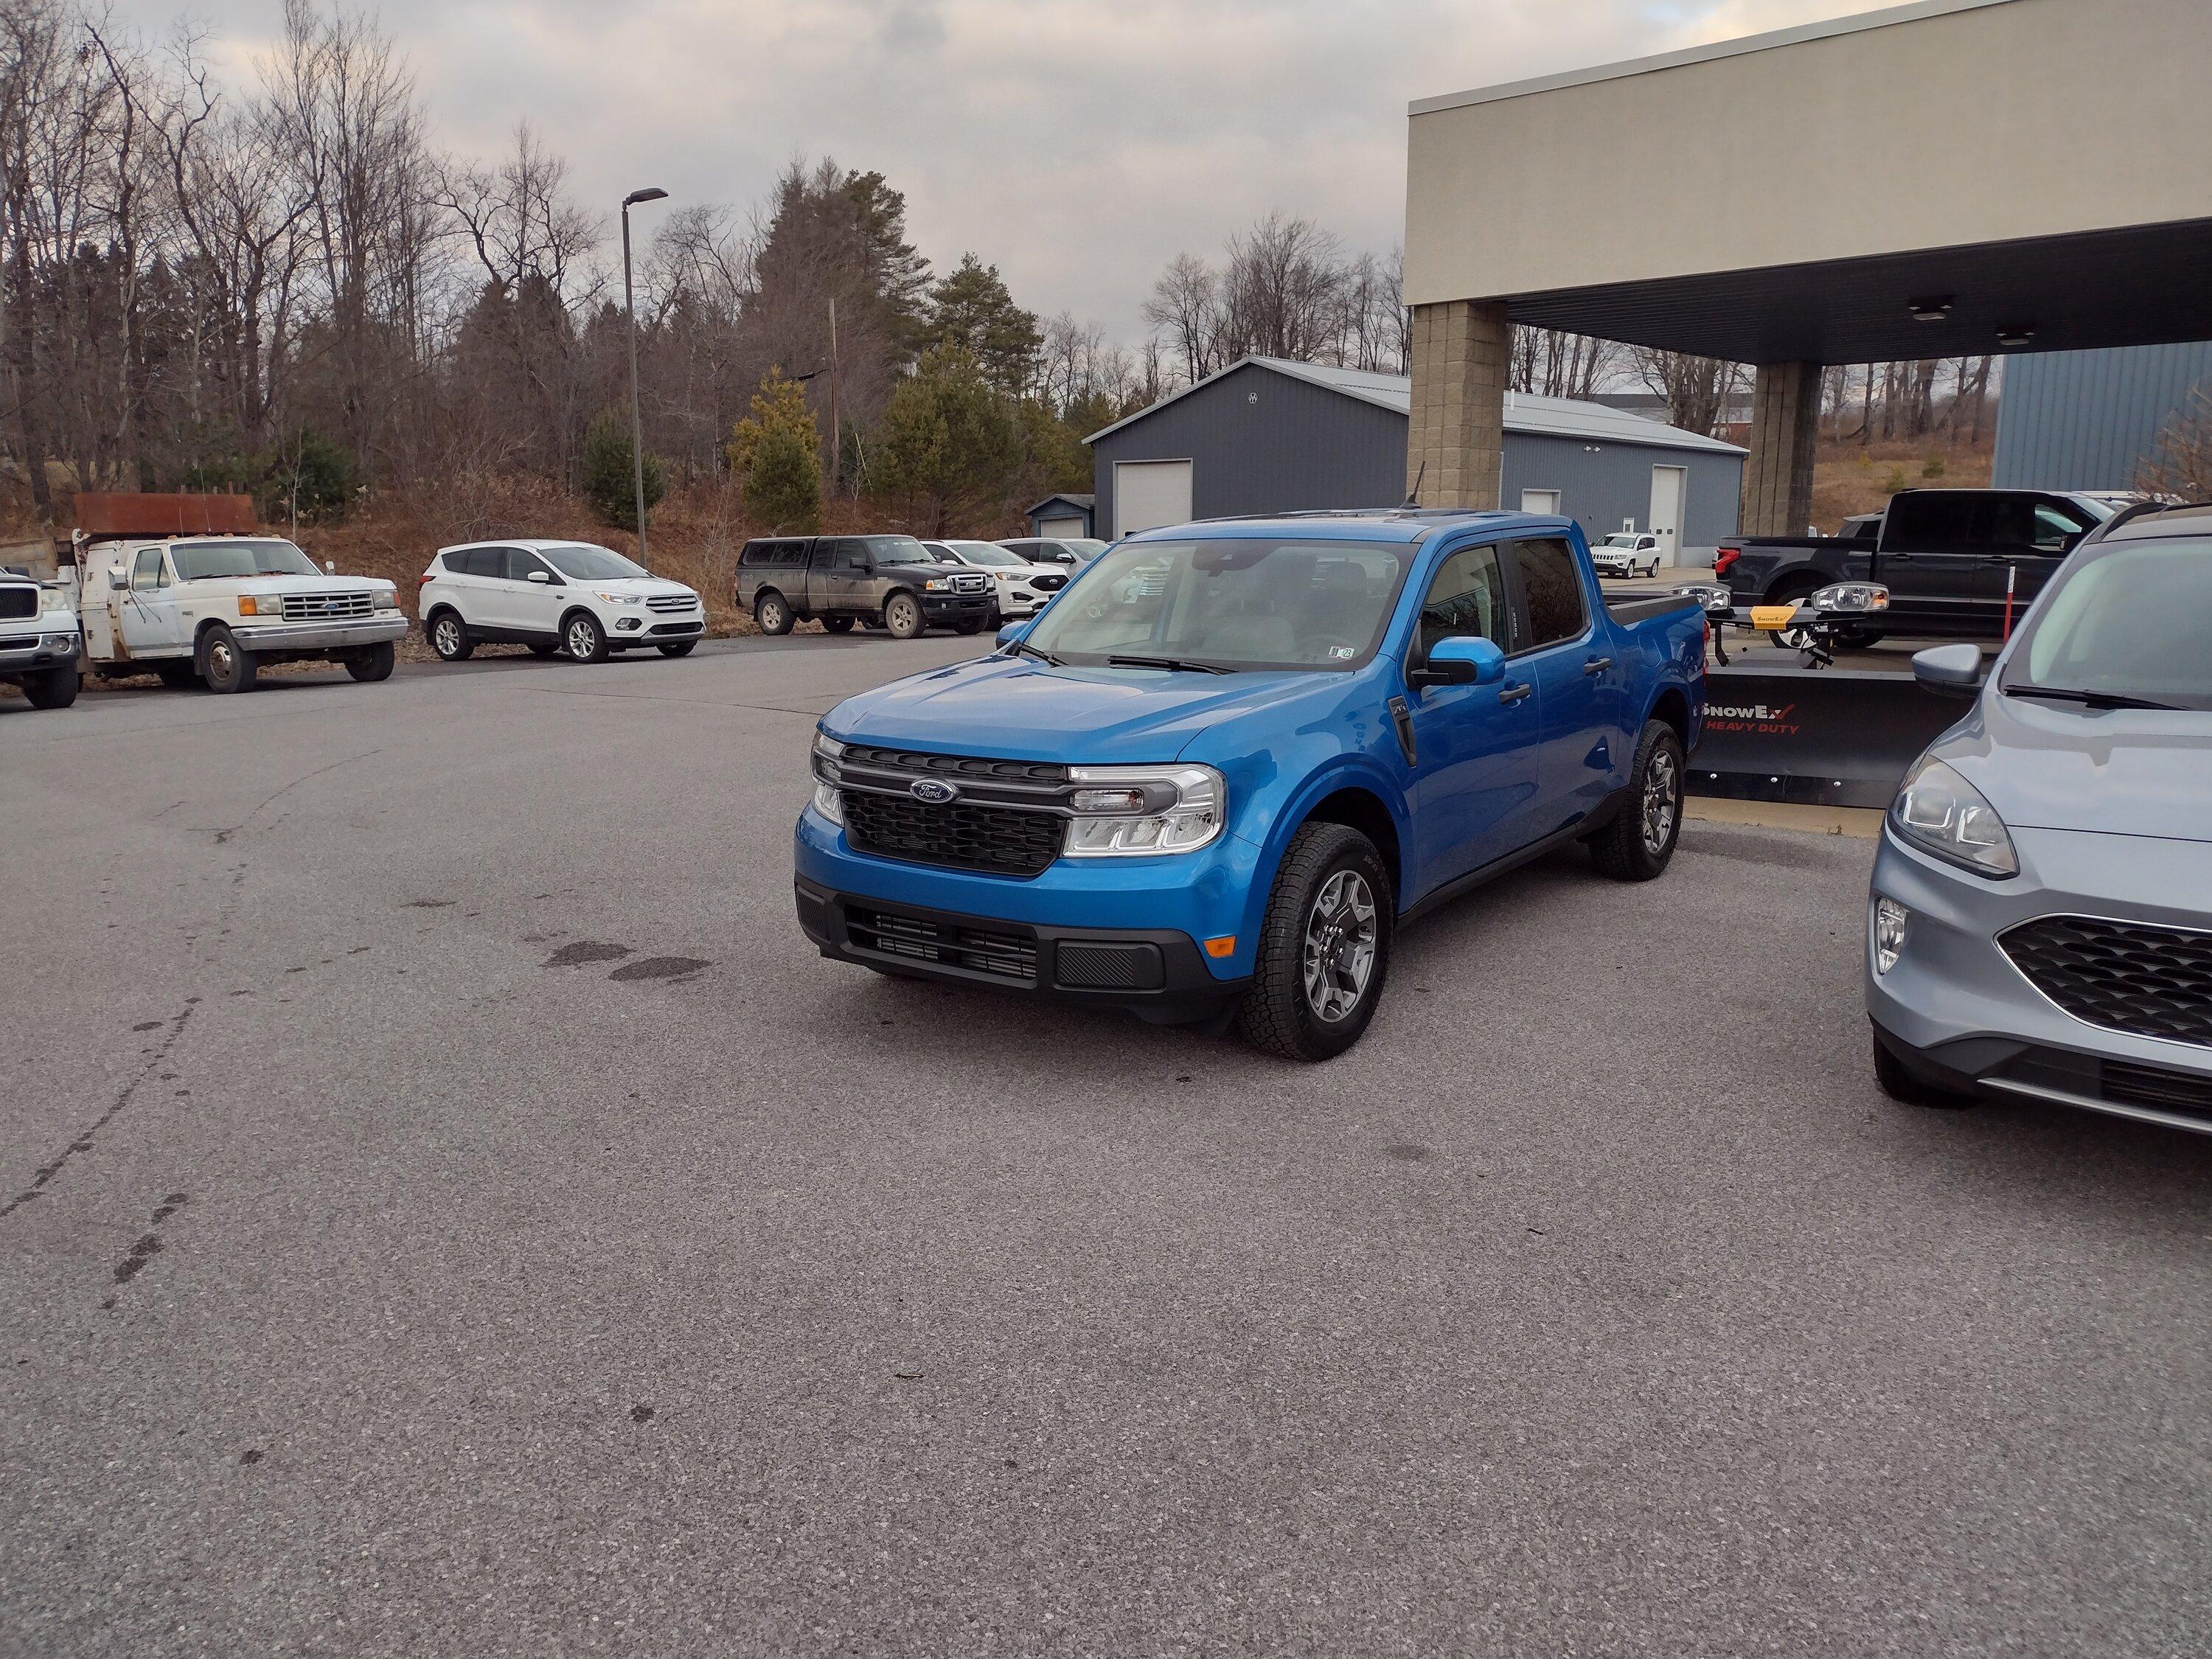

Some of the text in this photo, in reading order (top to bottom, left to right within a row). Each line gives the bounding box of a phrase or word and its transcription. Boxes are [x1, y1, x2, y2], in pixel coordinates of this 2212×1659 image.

[1343, 649, 1352, 657] 23
[1705, 720, 1799, 734] HEAVY DUTY
[919, 784, 942, 798] Ford
